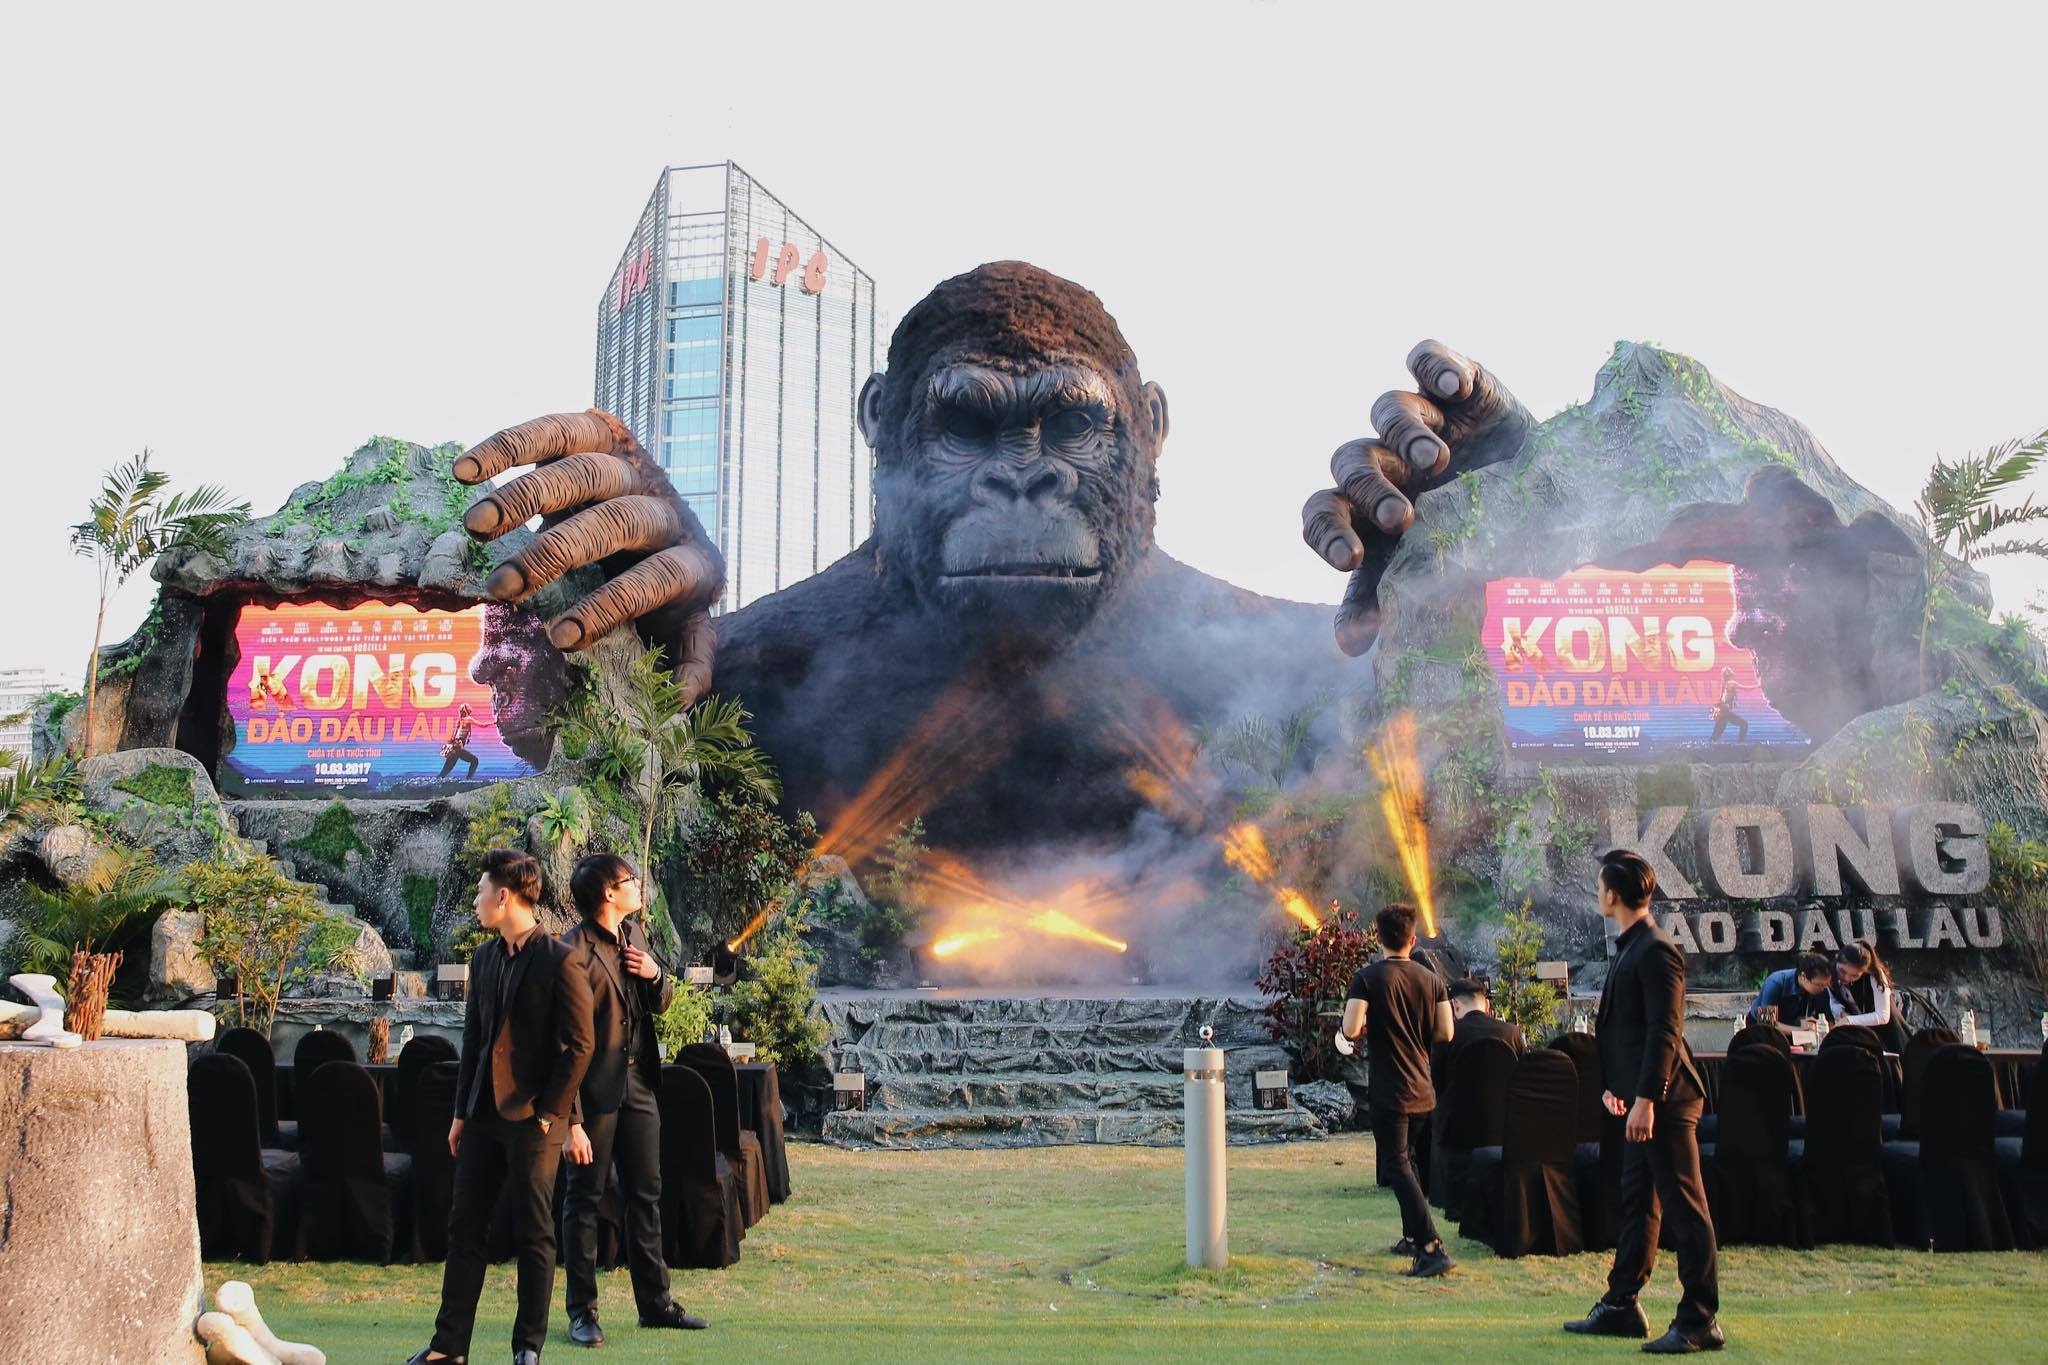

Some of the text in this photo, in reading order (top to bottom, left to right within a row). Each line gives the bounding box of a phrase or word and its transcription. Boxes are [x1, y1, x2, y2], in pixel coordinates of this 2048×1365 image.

[752, 236, 828, 294] IPC
[1501, 616, 1715, 673] KONG
[248, 653, 457, 711] KONG
[247, 711, 314, 744] ĐẢO
[1583, 726, 1640, 739] 10.03.2017
[315, 763, 371, 775] 10.03.2017
[1606, 802, 1991, 899] KONG
